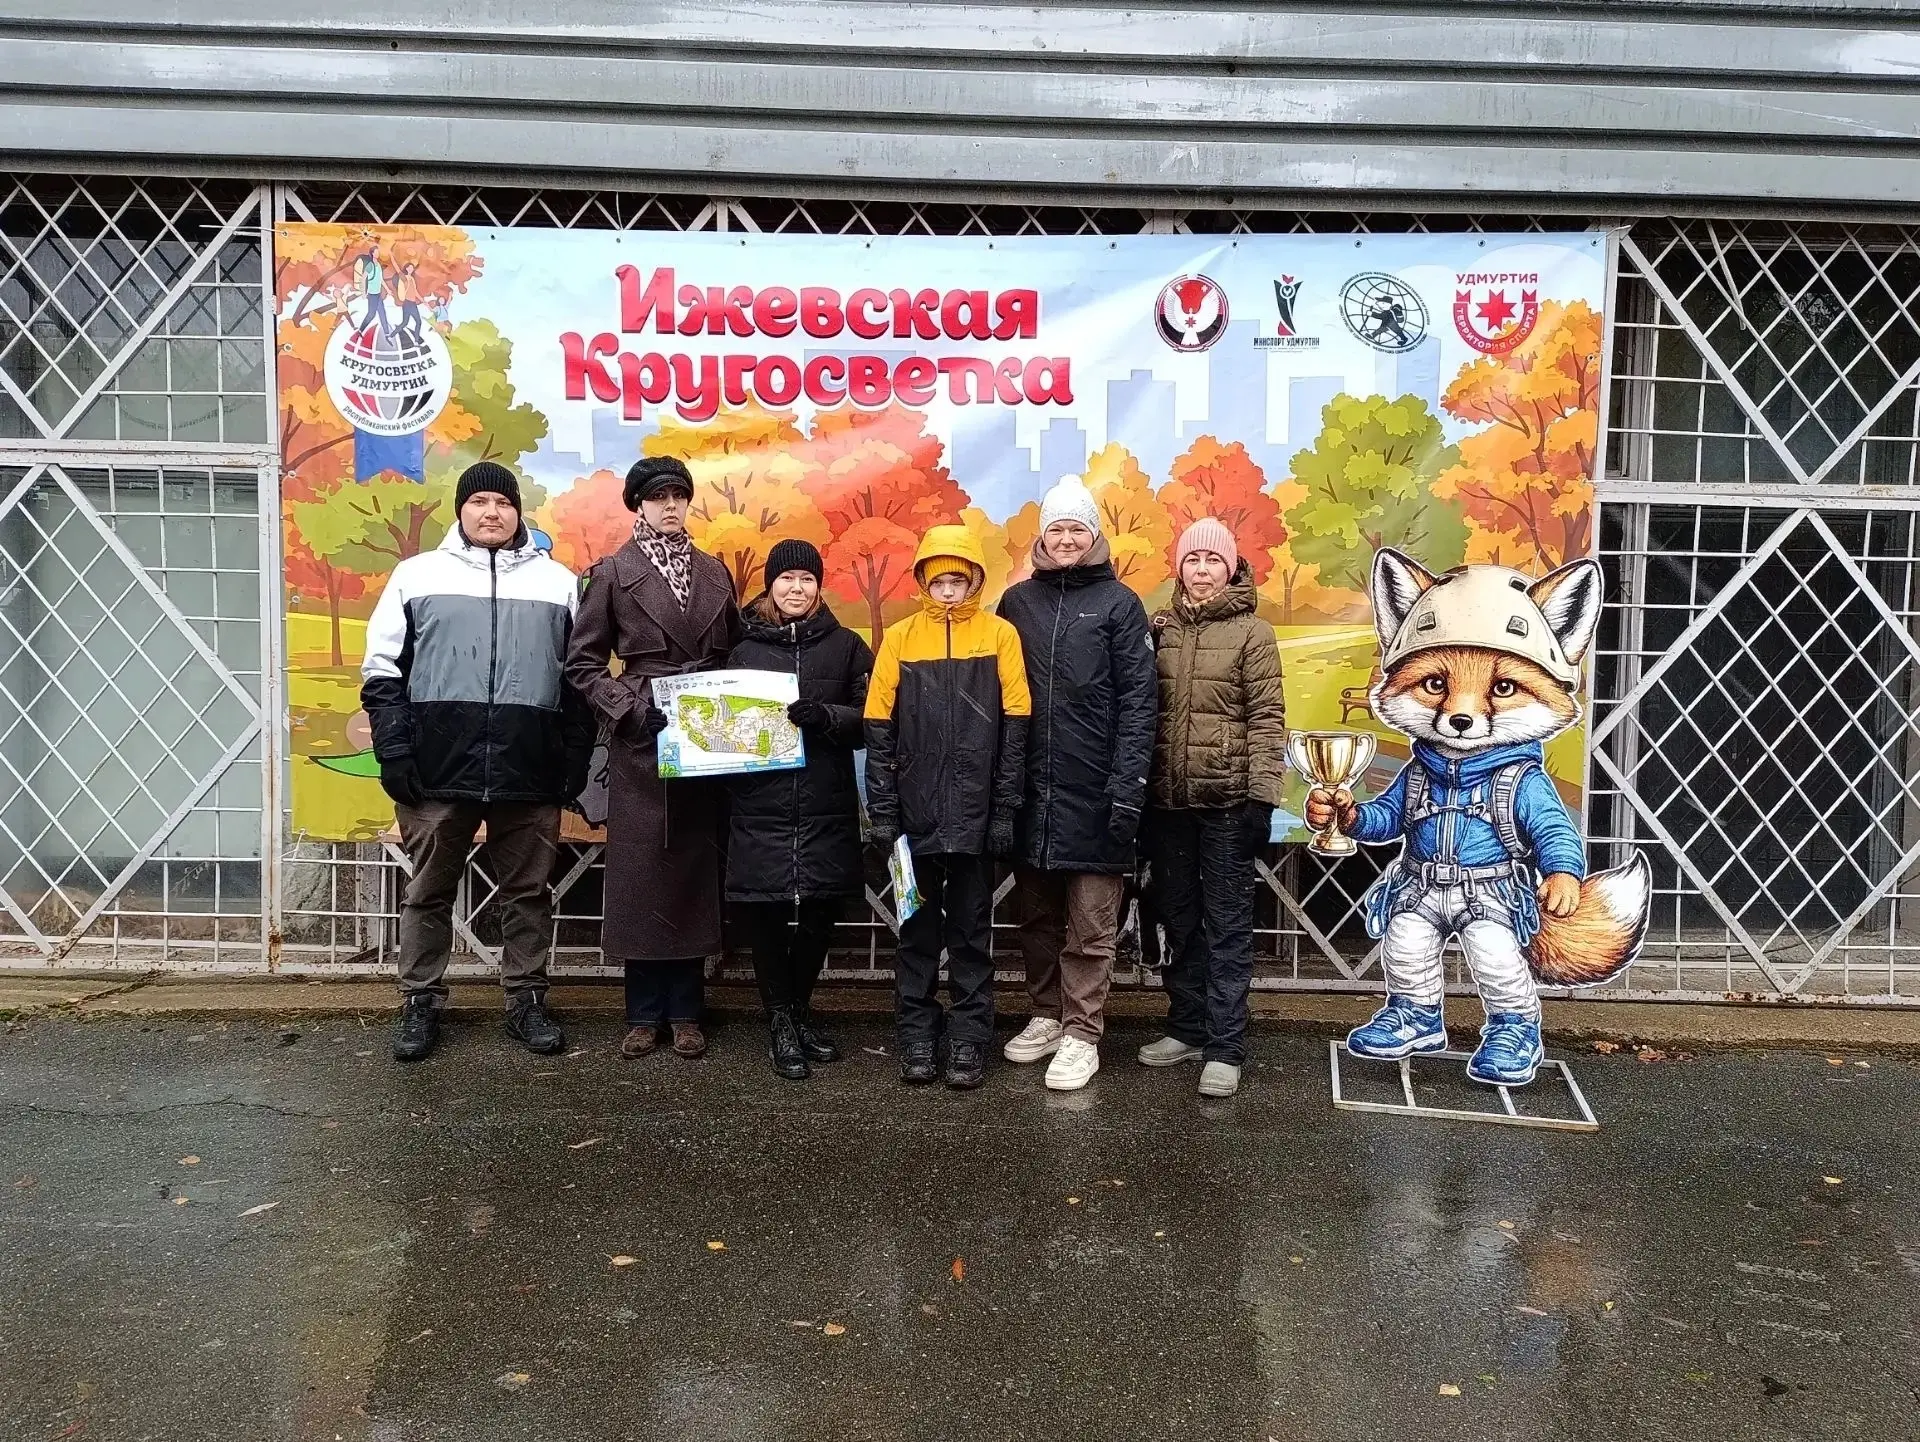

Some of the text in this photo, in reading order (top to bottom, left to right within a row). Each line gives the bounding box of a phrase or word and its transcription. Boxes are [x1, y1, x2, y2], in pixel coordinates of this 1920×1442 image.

[1456, 273, 1538, 285] УДМУРТИЯ
[615, 264, 1038, 340] Ижевская
[1456, 307, 1507, 350] ТЕРРИТОРИЯ
[1508, 307, 1535, 346] СПОРТА
[1286, 337, 1320, 347] УДМУРТИИ
[340, 355, 437, 376] КРУГОСВЕТКА
[559, 332, 1074, 422] Кругосветка
[351, 374, 428, 391] УДМУРТИИ
[343, 405, 435, 431] республиканский фестиваль
